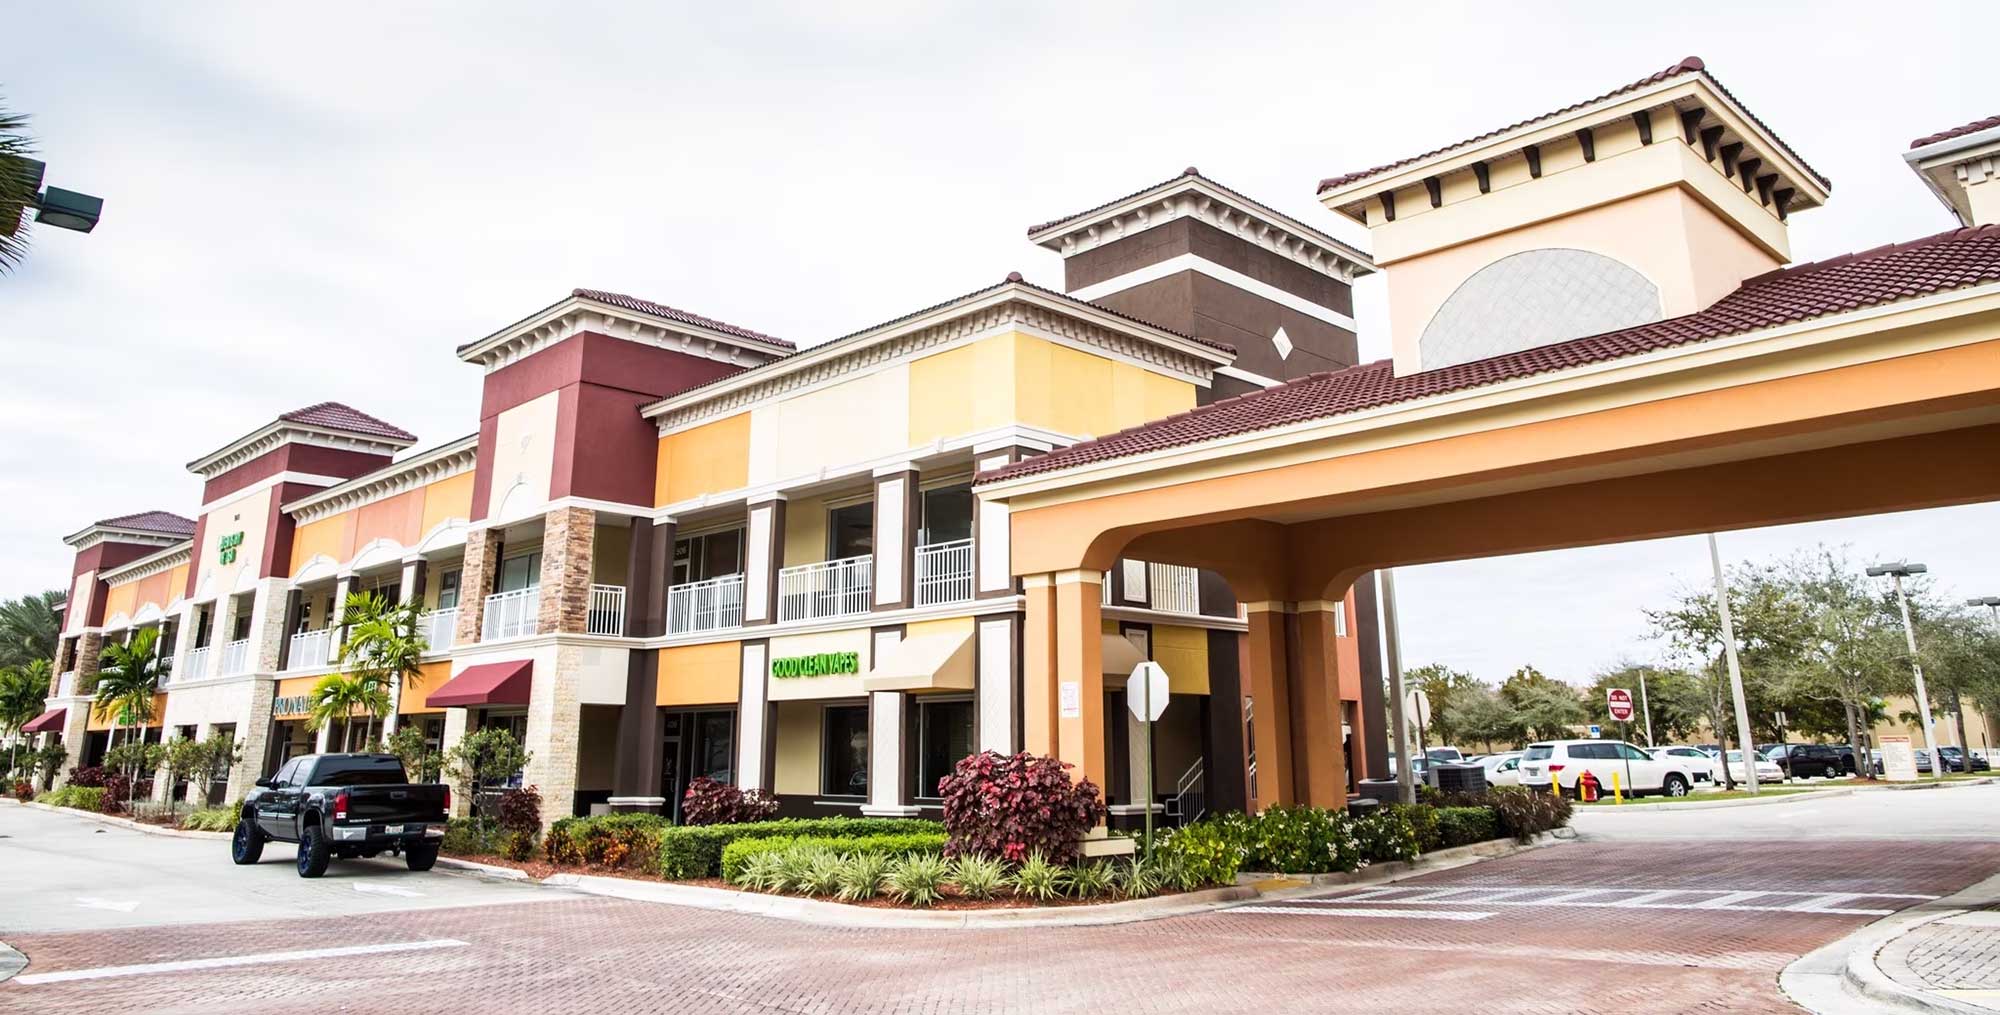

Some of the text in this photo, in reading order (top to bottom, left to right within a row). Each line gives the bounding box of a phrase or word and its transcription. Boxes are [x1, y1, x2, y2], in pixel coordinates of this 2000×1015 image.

[772, 651, 858, 678] GOOD CLEAN VAPES
